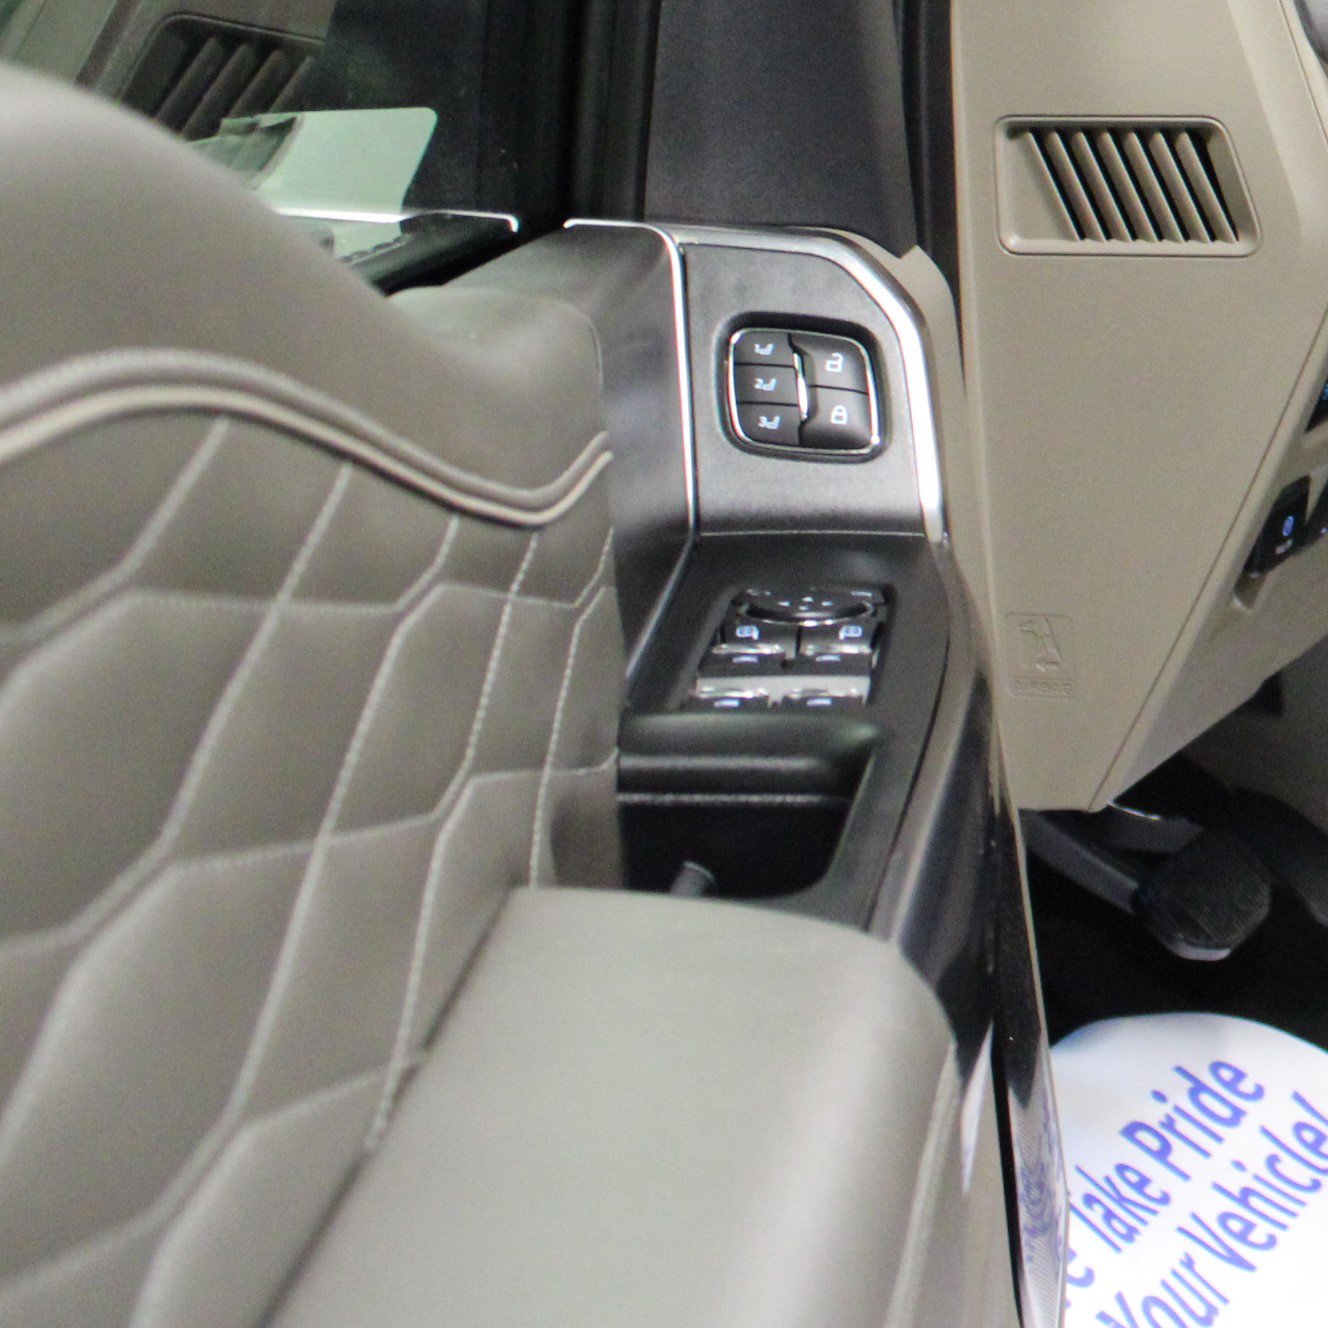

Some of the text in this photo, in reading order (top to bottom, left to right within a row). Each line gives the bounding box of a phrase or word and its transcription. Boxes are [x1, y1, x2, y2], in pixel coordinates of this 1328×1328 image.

[754, 377, 764, 390] 2
[757, 415, 767, 428] 3
[1119, 1061, 1265, 1182] Pride
